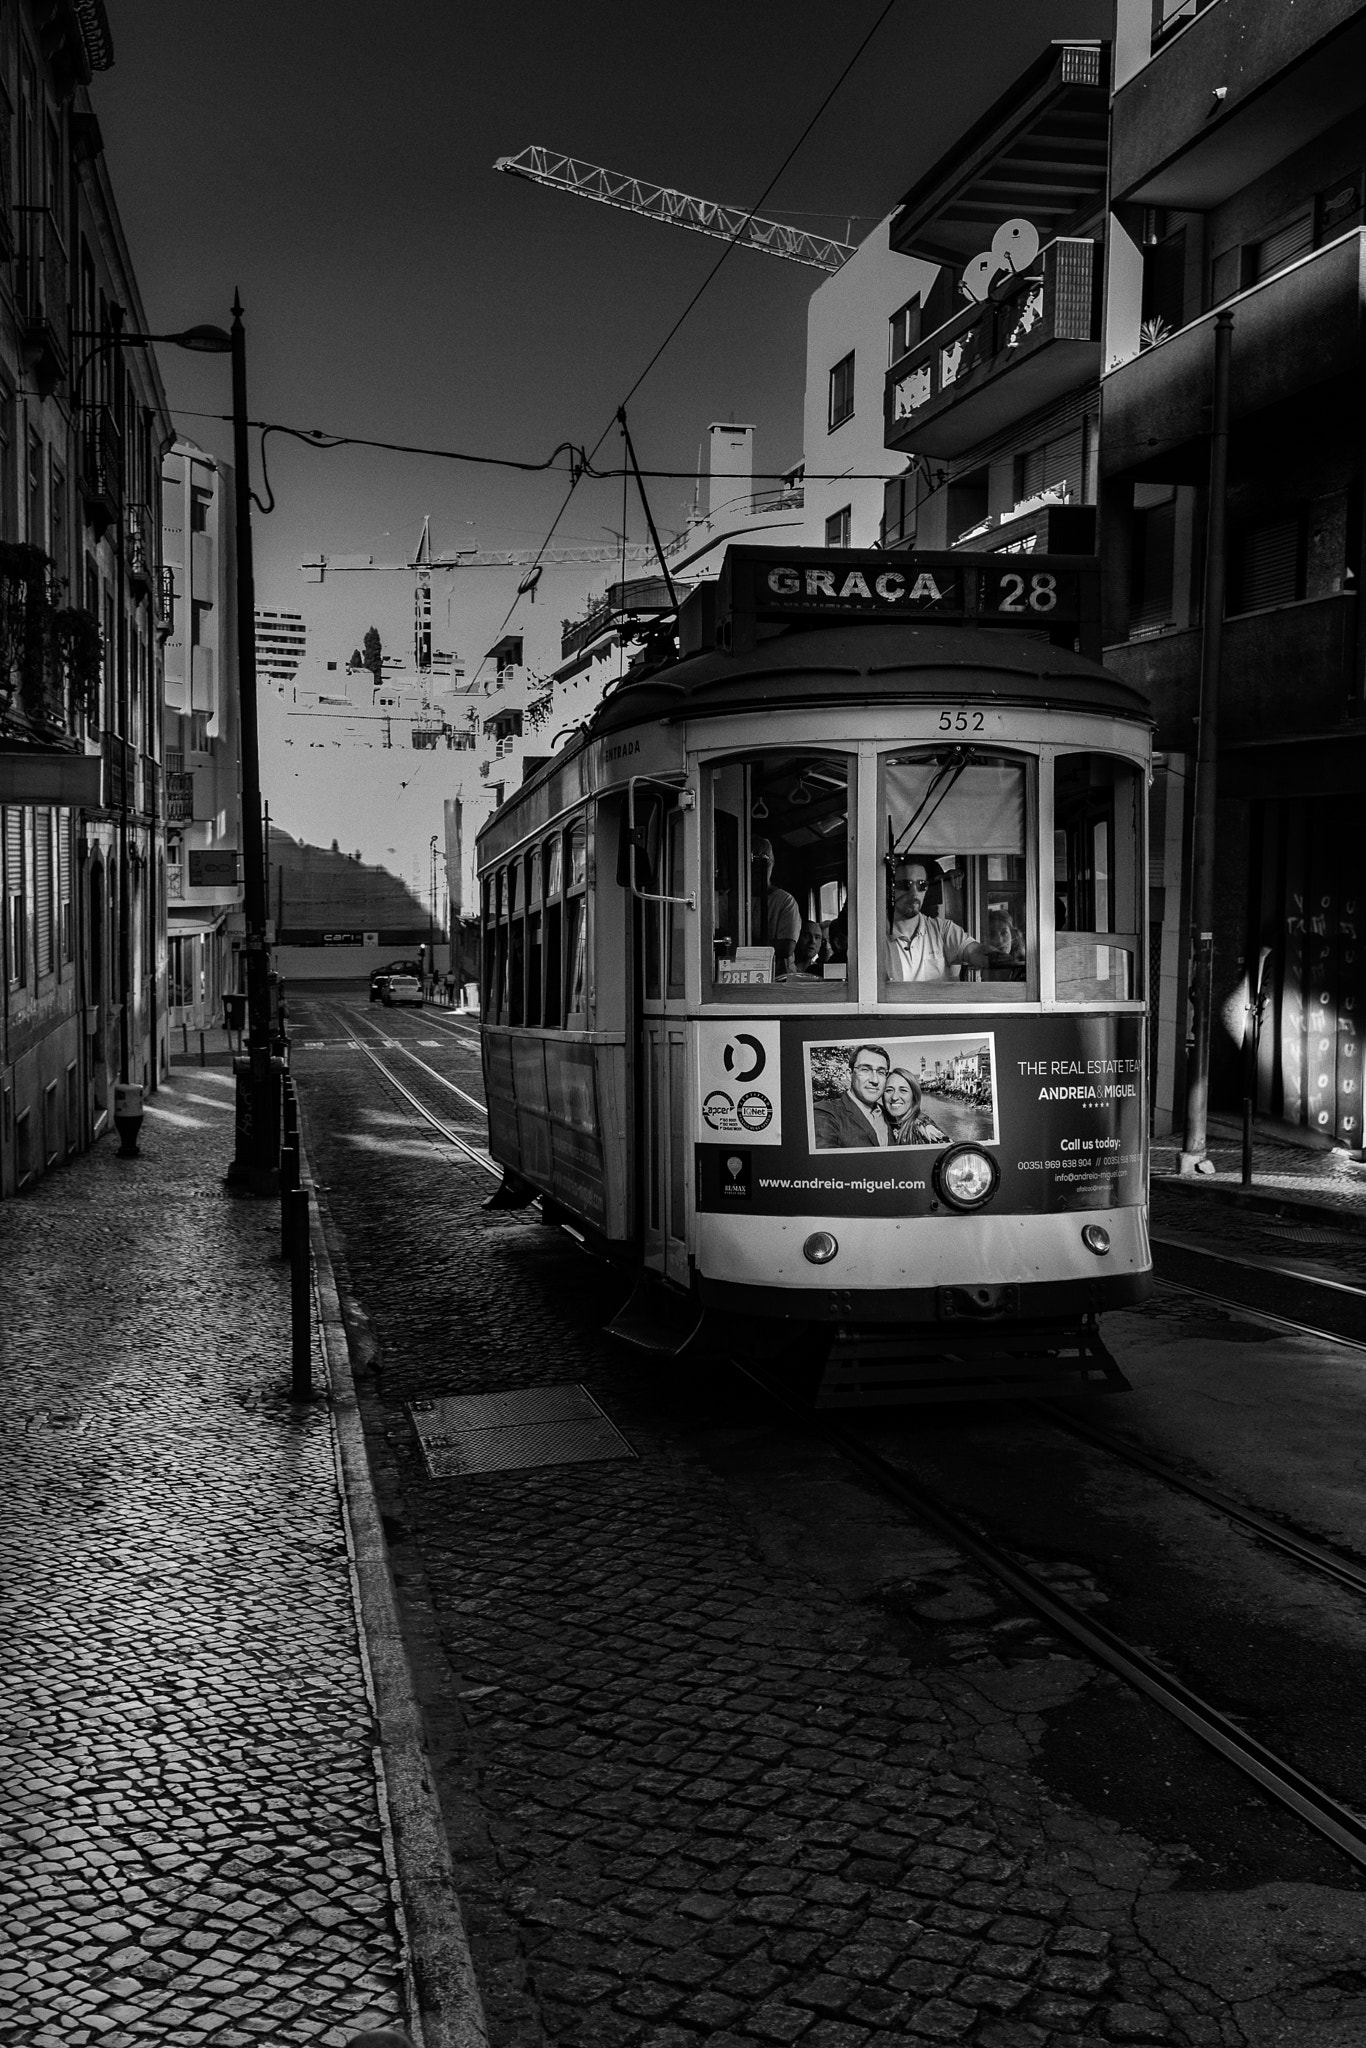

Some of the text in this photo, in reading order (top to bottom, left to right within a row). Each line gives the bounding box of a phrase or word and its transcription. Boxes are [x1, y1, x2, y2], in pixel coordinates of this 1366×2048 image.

[767, 567, 943, 602] GRAÇA
[998, 572, 1058, 613] 28
[938, 711, 985, 731] 552
[605, 740, 641, 763] ENTRADA
[1017, 1061, 1047, 1076] THE
[1051, 1060, 1085, 1075] REAL
[1087, 1059, 1124, 1074] ESTATE
[1038, 1084, 1137, 1101] ANDREIA&MIGUEL
[1060, 1137, 1121, 1151] Call us today:
[1017, 1161, 1043, 1170] 00351
[1044, 1160, 1061, 1169] 969
[1061, 1159, 1076, 1168] 638
[1077, 1158, 1092, 1167] 904
[758, 1177, 926, 1193] www.andreia-miguel.com
